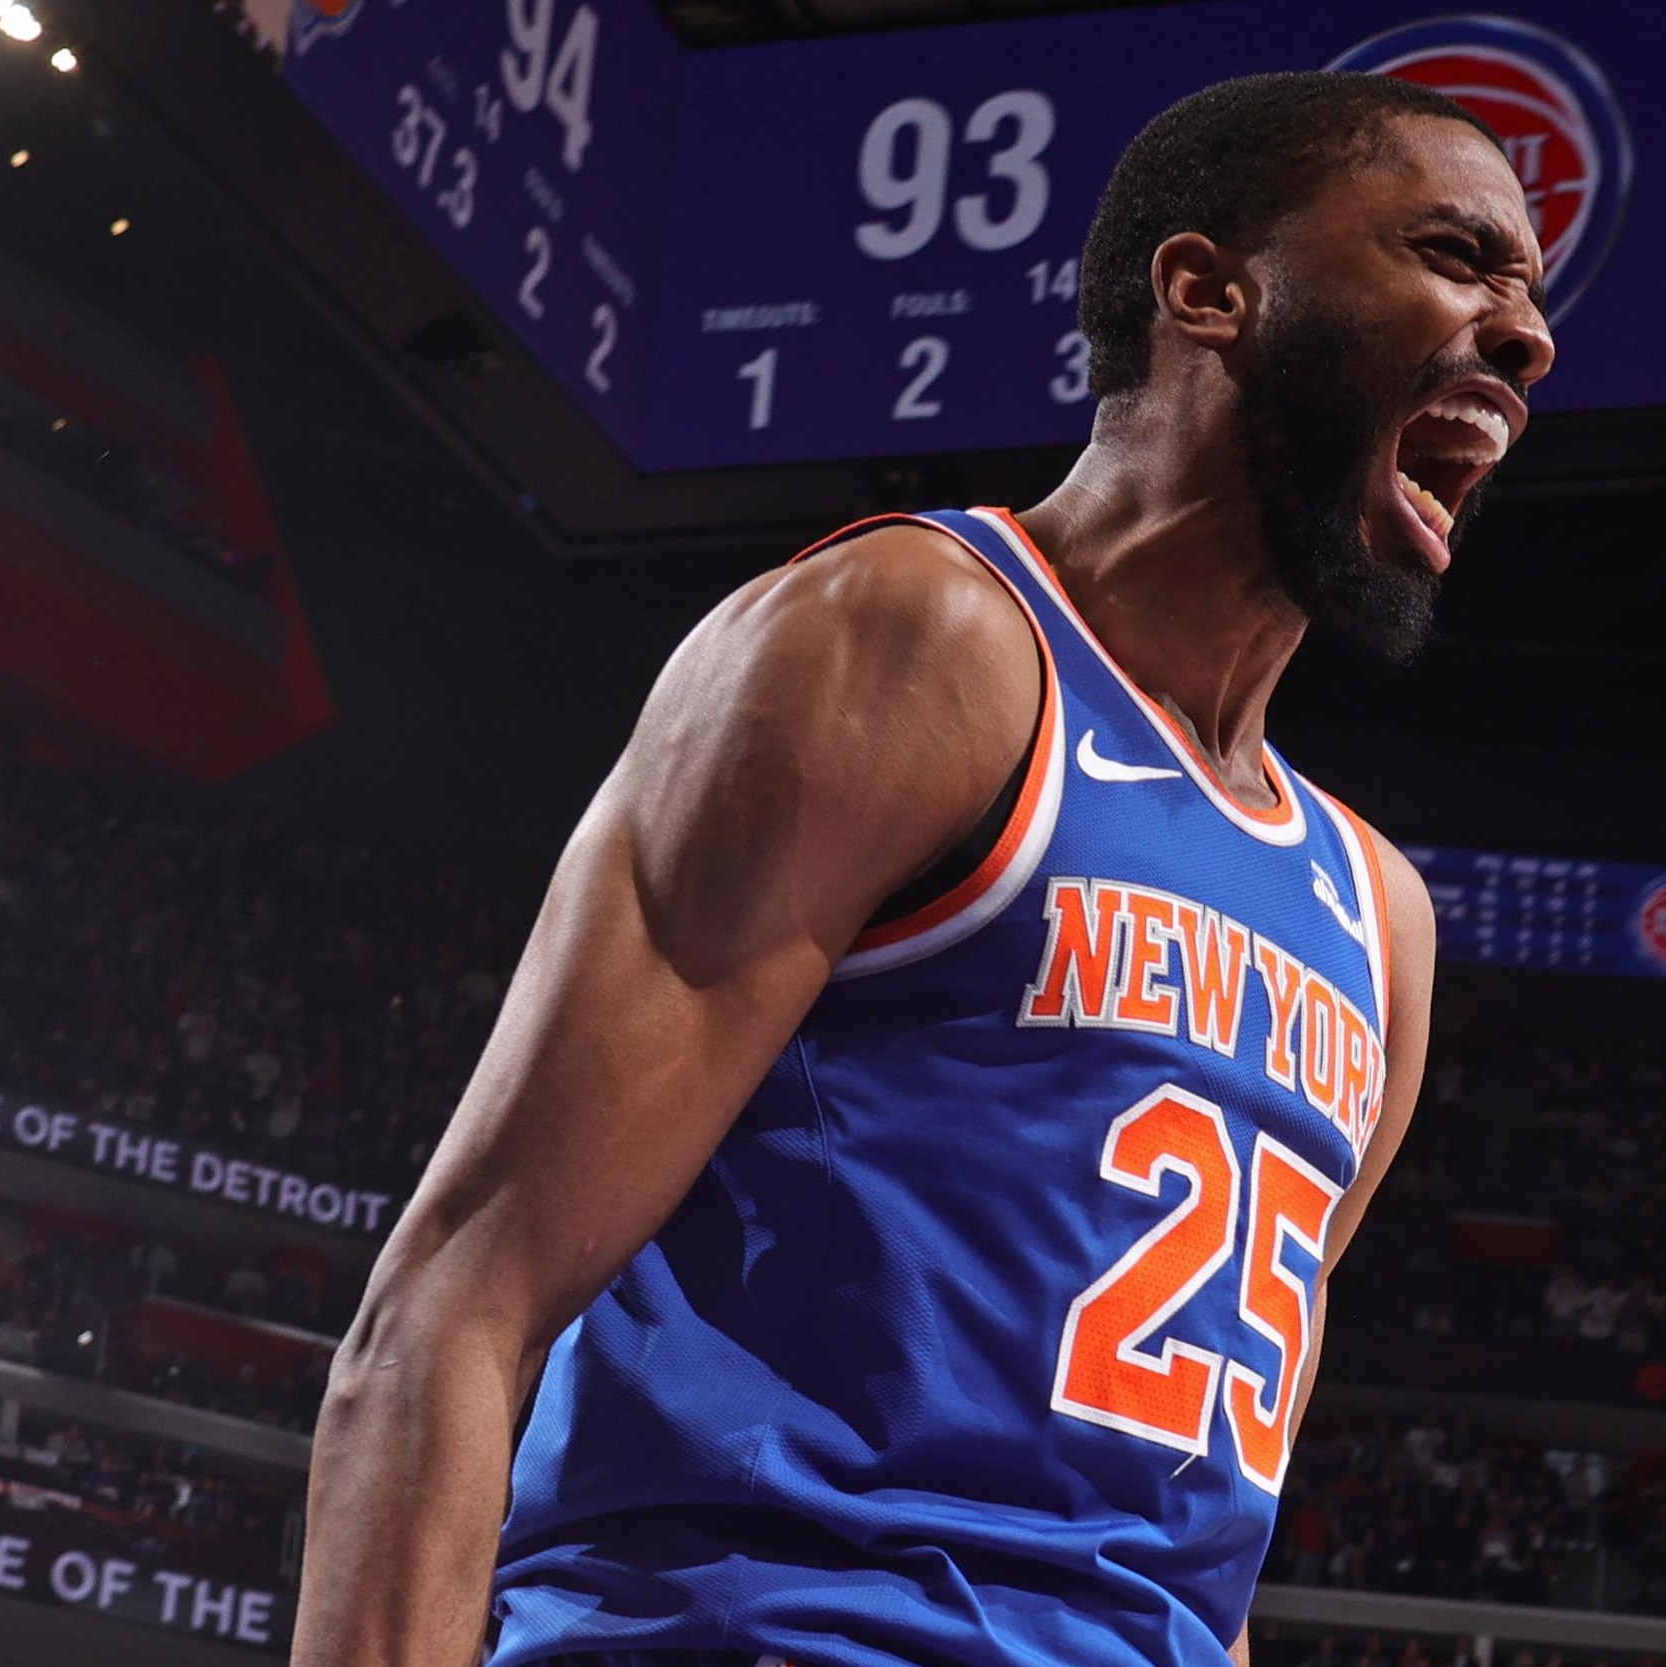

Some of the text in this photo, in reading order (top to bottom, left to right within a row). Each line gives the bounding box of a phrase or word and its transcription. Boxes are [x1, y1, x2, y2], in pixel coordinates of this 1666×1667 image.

[500, 0, 599, 171] 94
[853, 89, 1056, 259] 93
[519, 226, 551, 319] 2
[1026, 258, 1079, 304] 14
[585, 302, 617, 394] 2
[737, 348, 778, 429] 1
[891, 336, 950, 420] 2
[1050, 330, 1091, 404] 3
[1016, 877, 1250, 1058] NEW
[12, 1105, 80, 1152] OF
[87, 1123, 180, 1184] THE
[190, 1151, 390, 1232] DETROIT
[1051, 1082, 1345, 1498] 25
[51, 1551, 137, 1611] OF
[154, 1569, 273, 1645] THE
